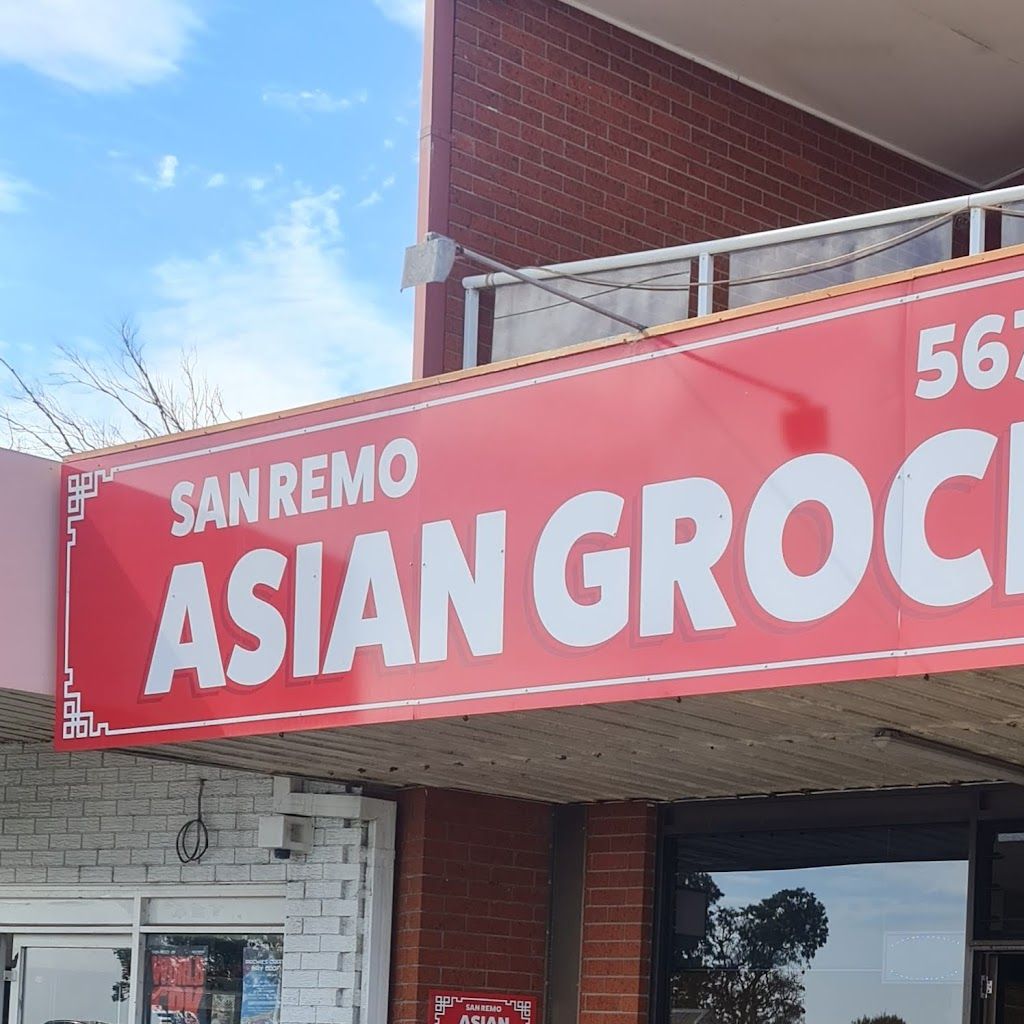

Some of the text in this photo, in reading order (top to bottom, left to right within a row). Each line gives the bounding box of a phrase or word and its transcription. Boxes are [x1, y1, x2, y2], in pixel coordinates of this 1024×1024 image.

[169, 437, 420, 538] SAN REMO
[143, 509, 507, 696] ASIAN
[465, 1003, 502, 1013] SAN REMO
